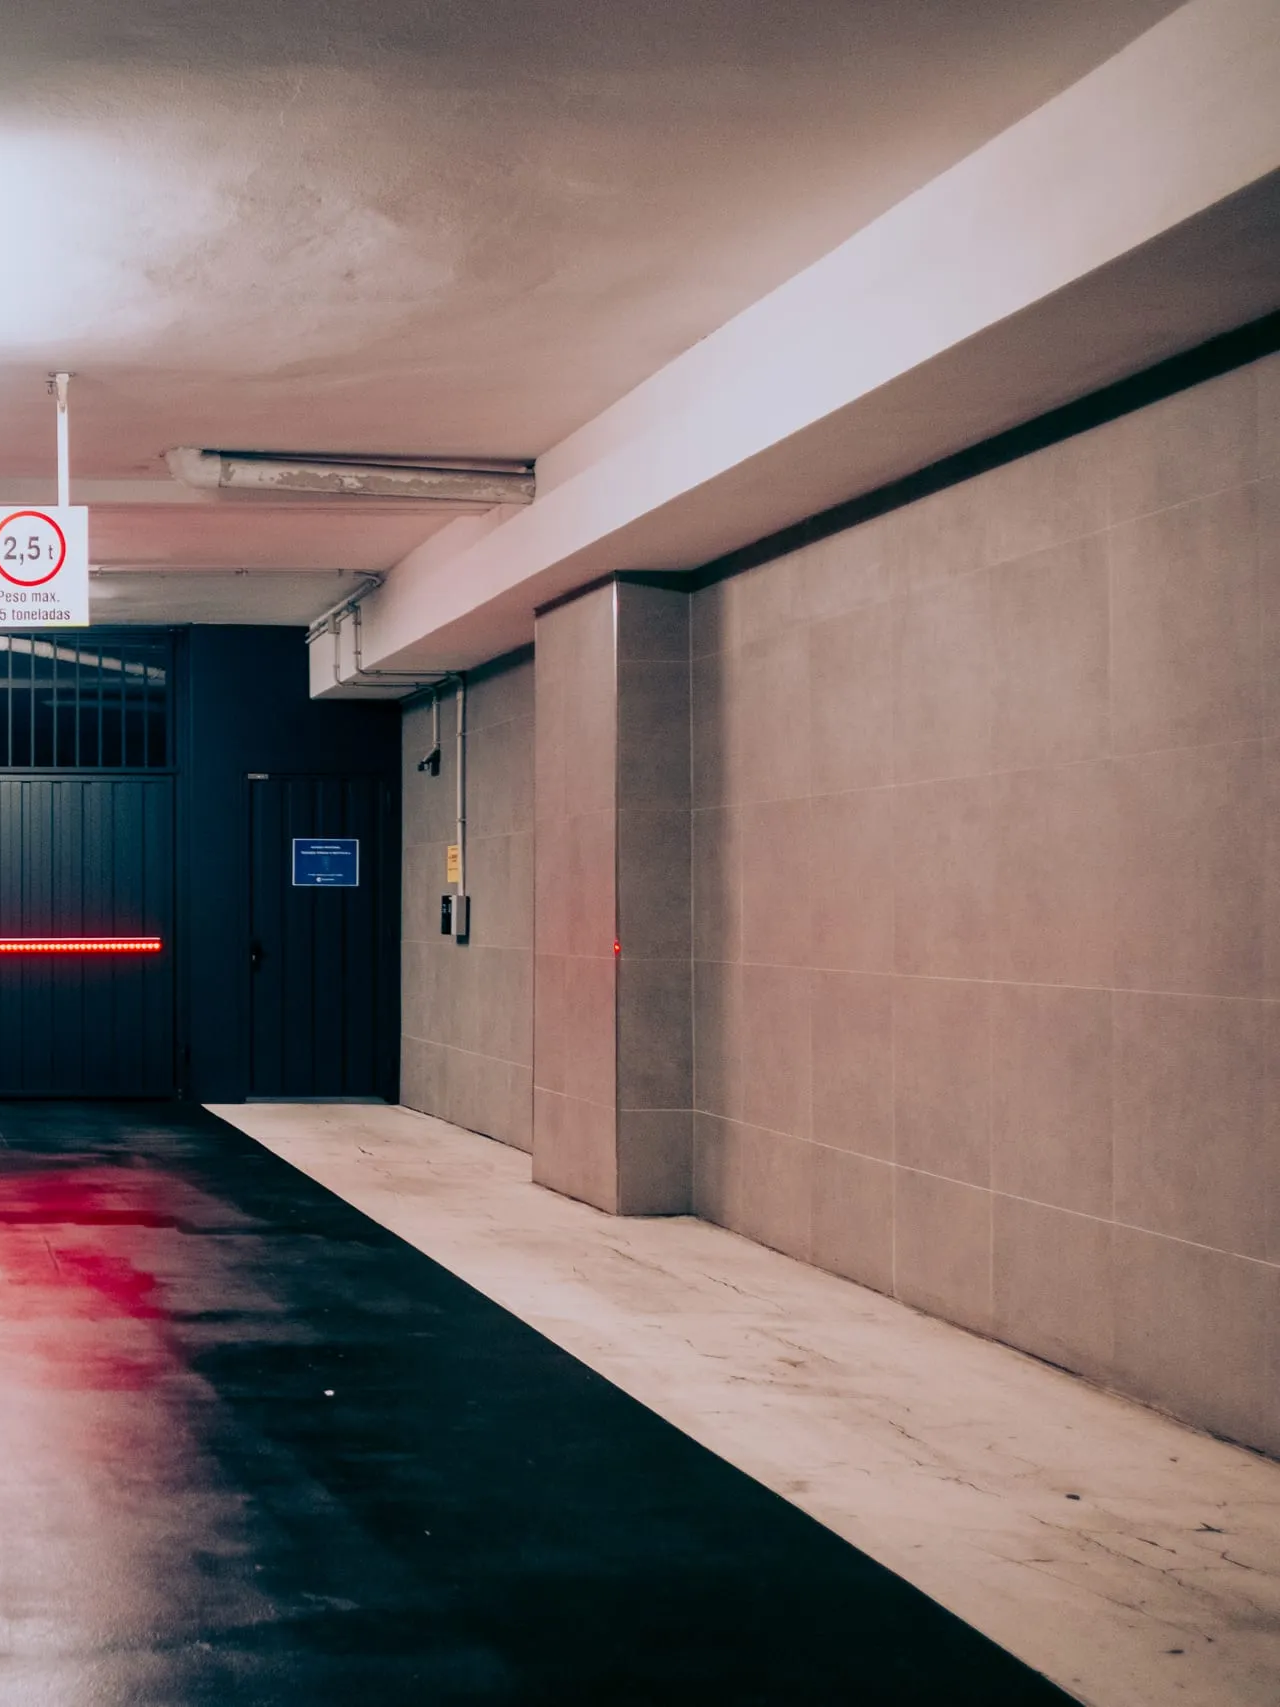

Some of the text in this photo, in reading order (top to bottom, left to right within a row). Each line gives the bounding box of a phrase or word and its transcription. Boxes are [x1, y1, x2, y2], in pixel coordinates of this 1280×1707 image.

[3, 536, 54, 565] 2,5 t
[31, 592, 60, 603] max.
[11, 608, 71, 621] toneladas
